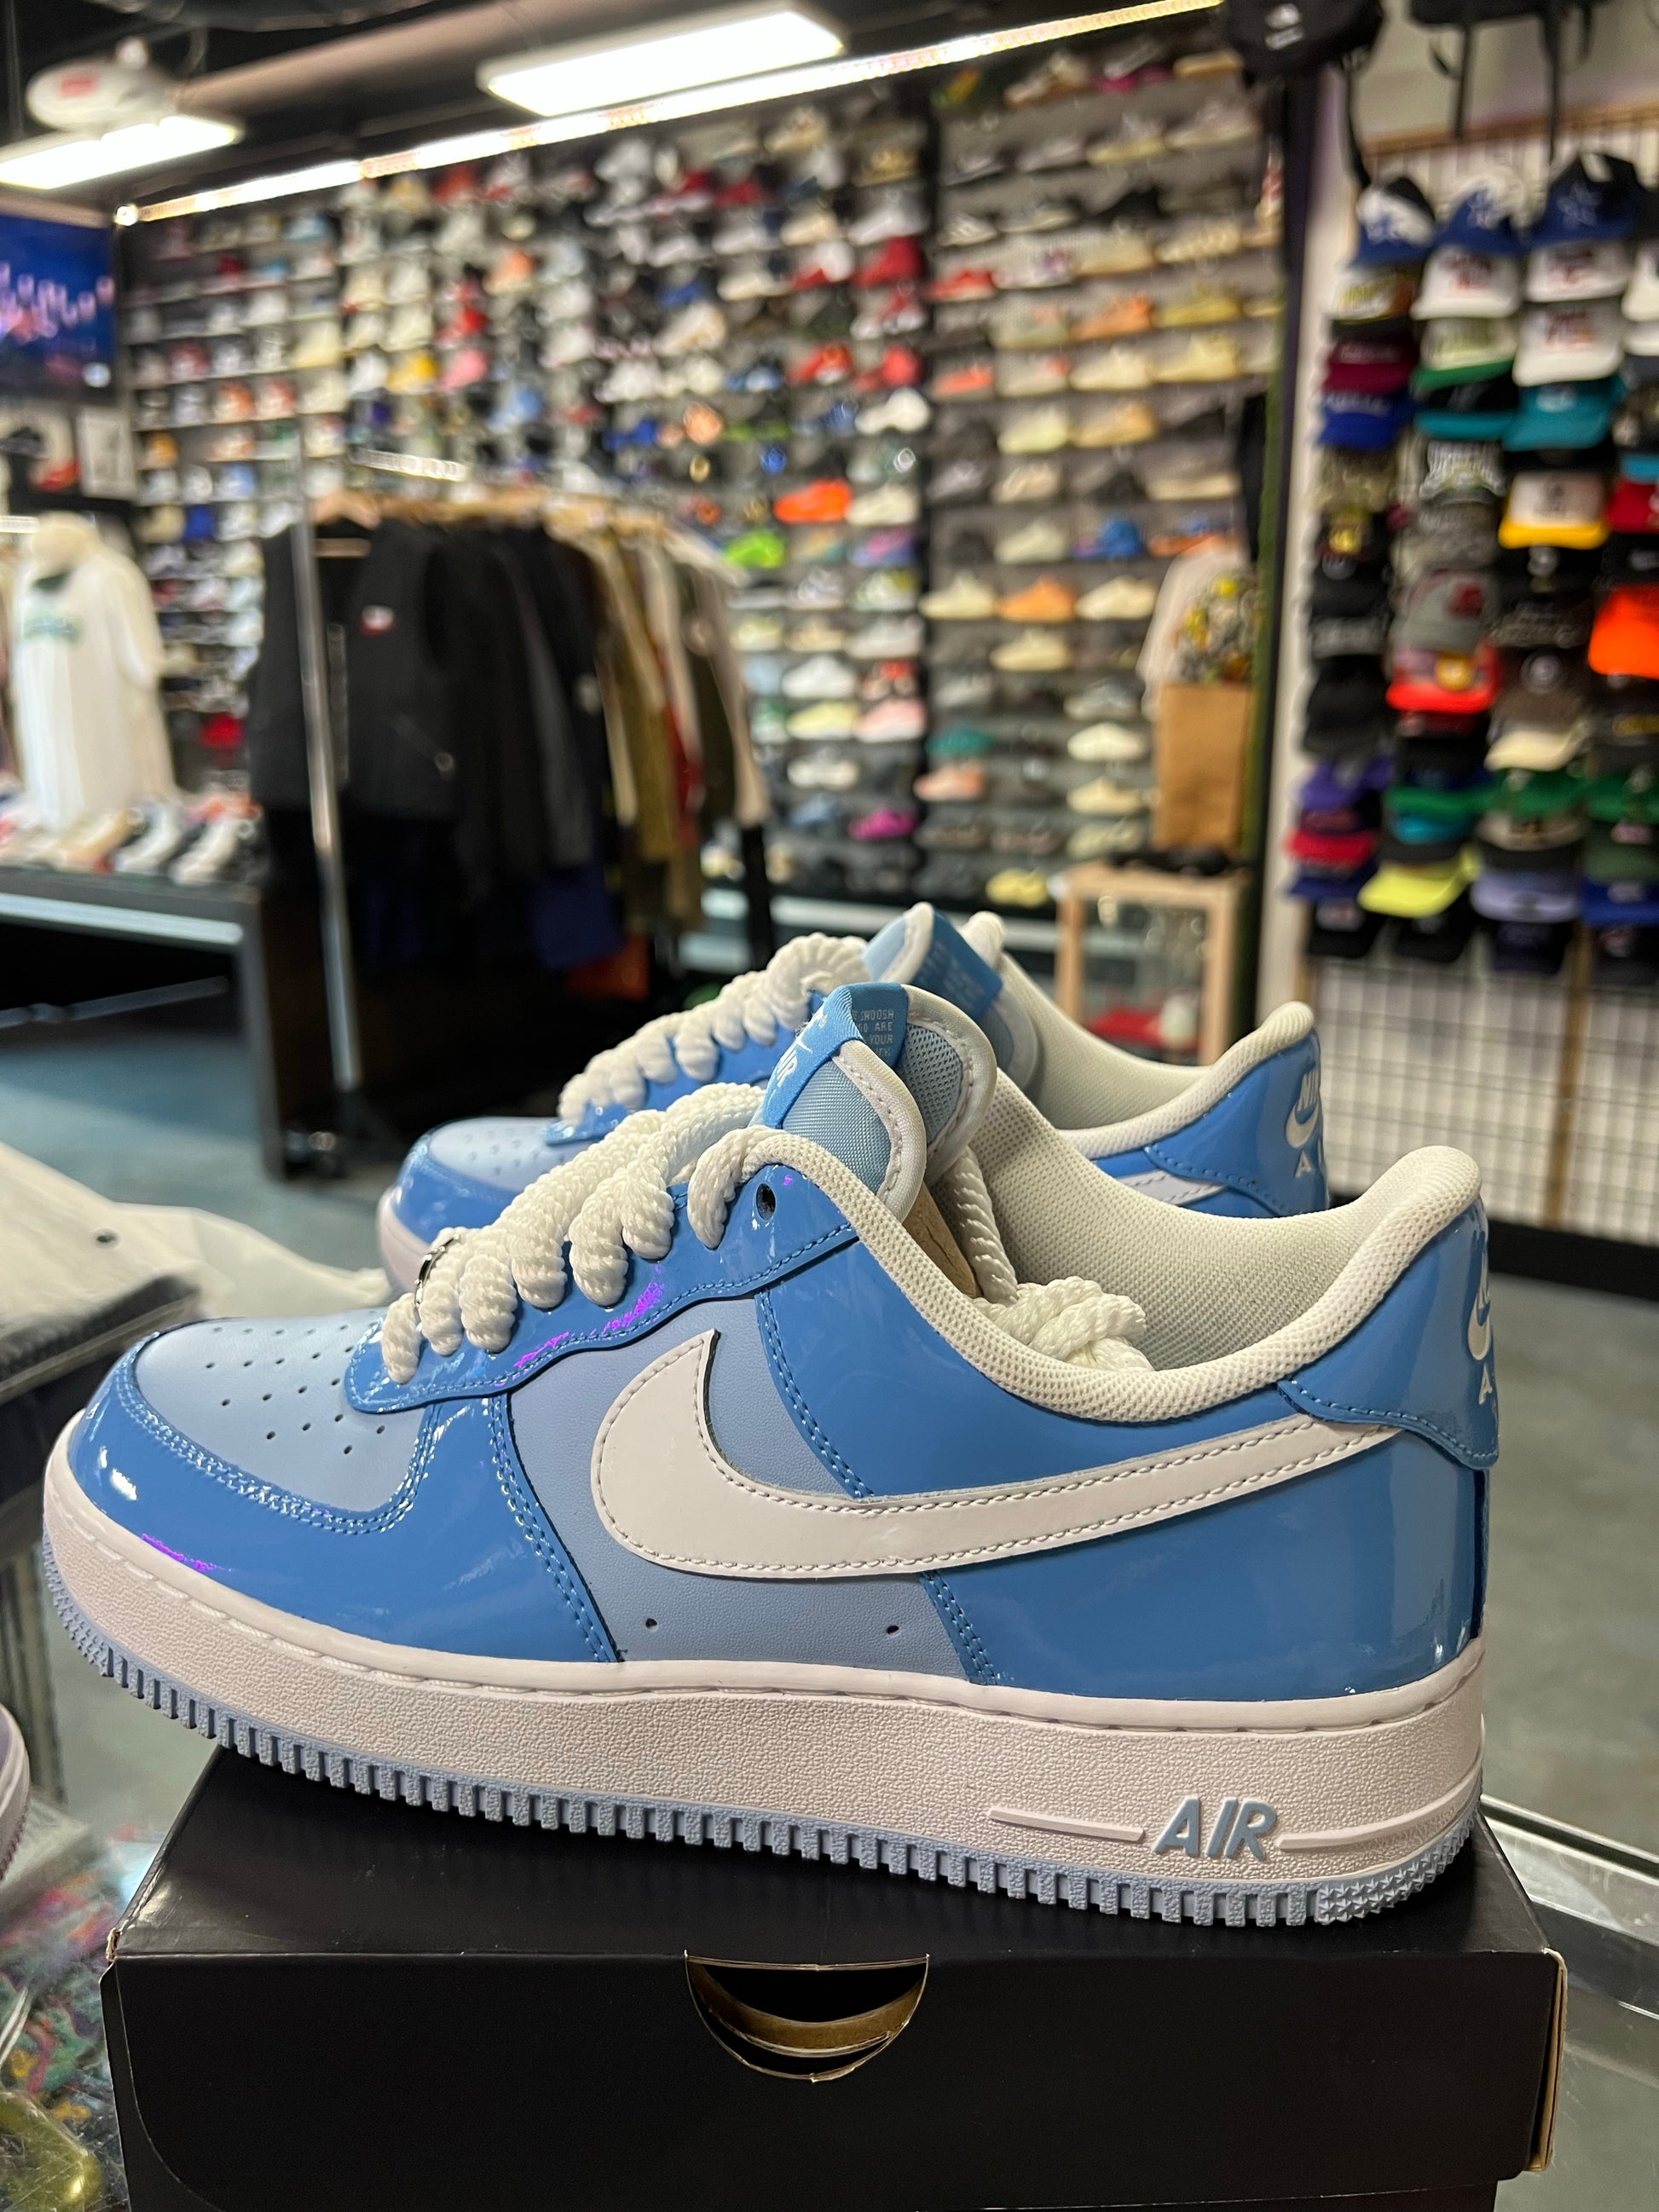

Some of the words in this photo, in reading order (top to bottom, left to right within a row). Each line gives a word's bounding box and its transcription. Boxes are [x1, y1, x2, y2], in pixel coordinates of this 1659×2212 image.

[859, 1008, 894, 1021] SWOOSH
[874, 1021, 893, 1032] ARE
[869, 1034, 893, 1045] YOUR
[1153, 1795, 1278, 1862] AIR
